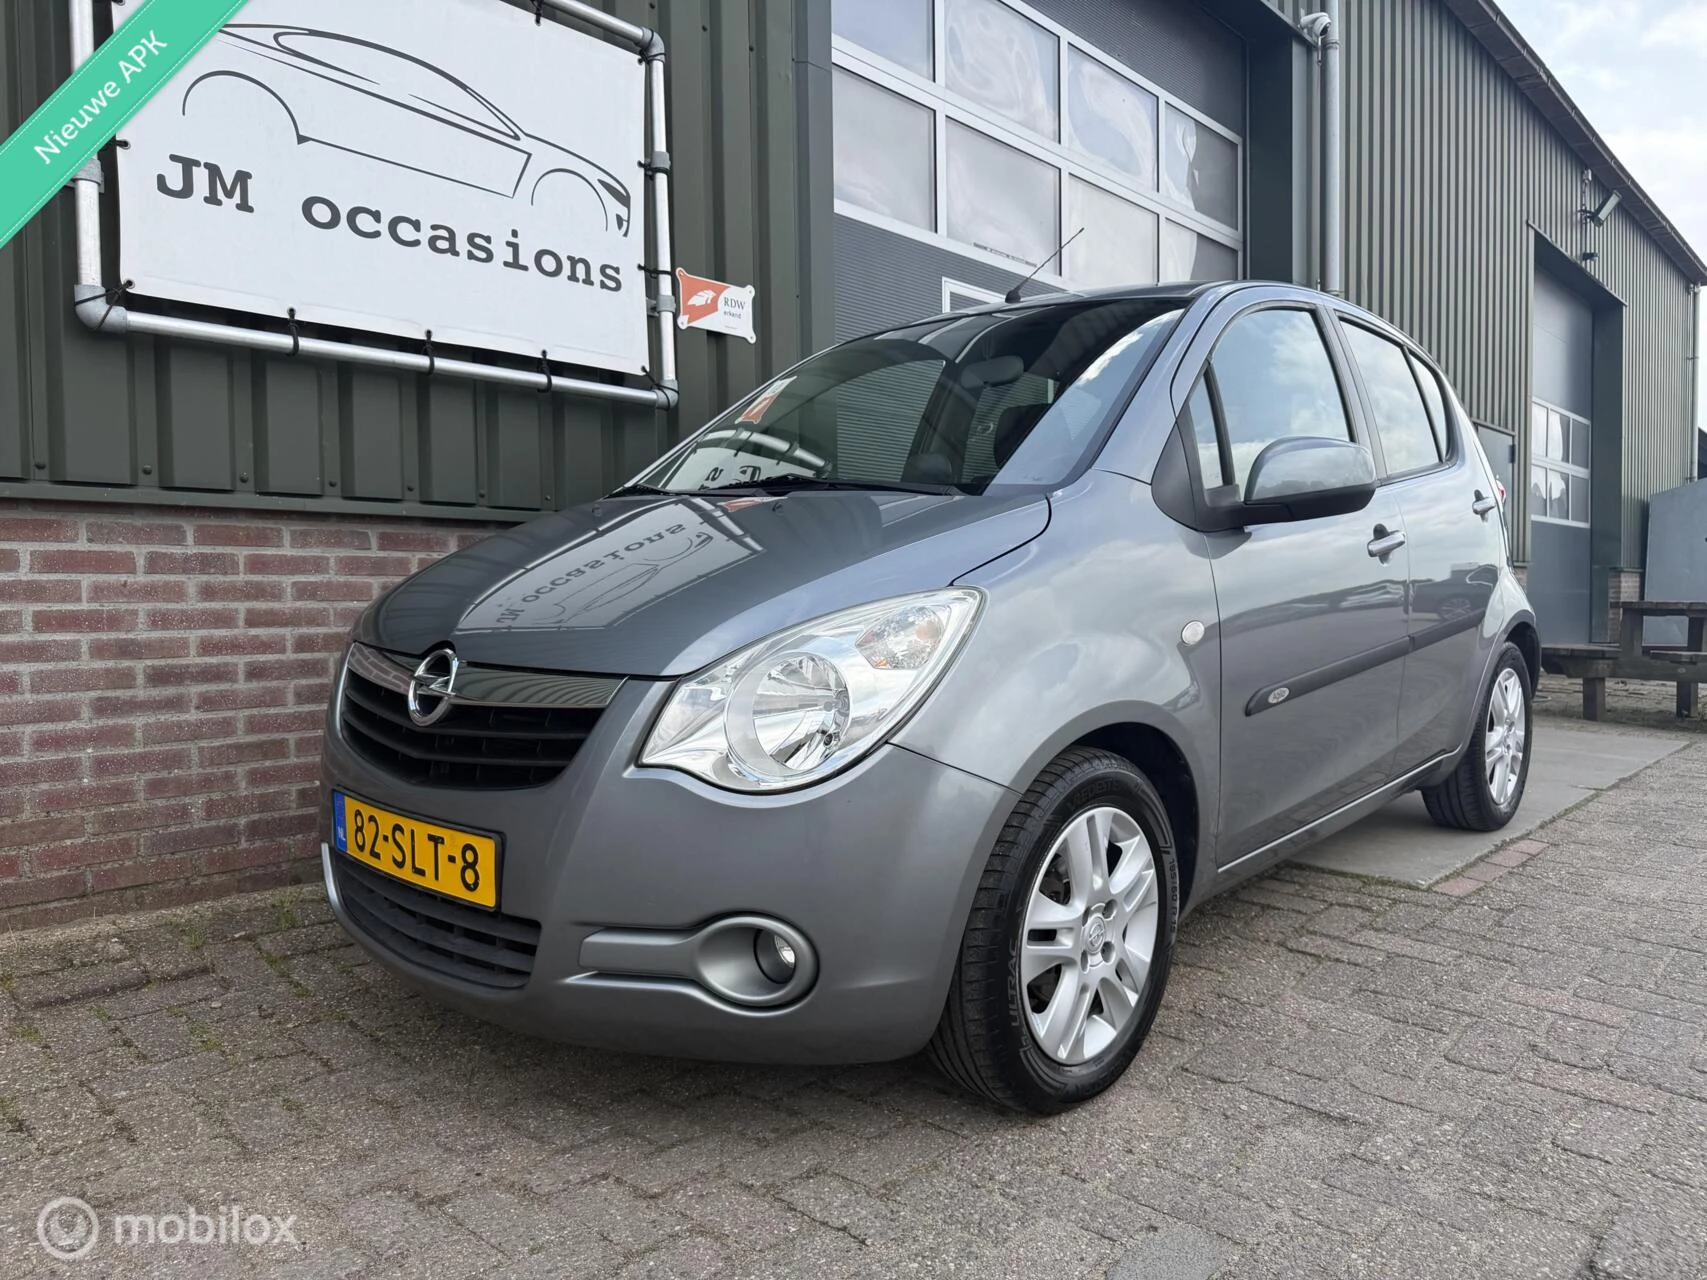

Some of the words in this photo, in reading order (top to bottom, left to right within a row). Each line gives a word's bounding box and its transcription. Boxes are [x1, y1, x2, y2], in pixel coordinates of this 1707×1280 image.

[156, 153, 255, 213] JM
[301, 195, 623, 292] occasions
[723, 296, 746, 310] RDW
[354, 809, 480, 892] 82-SLT-8
